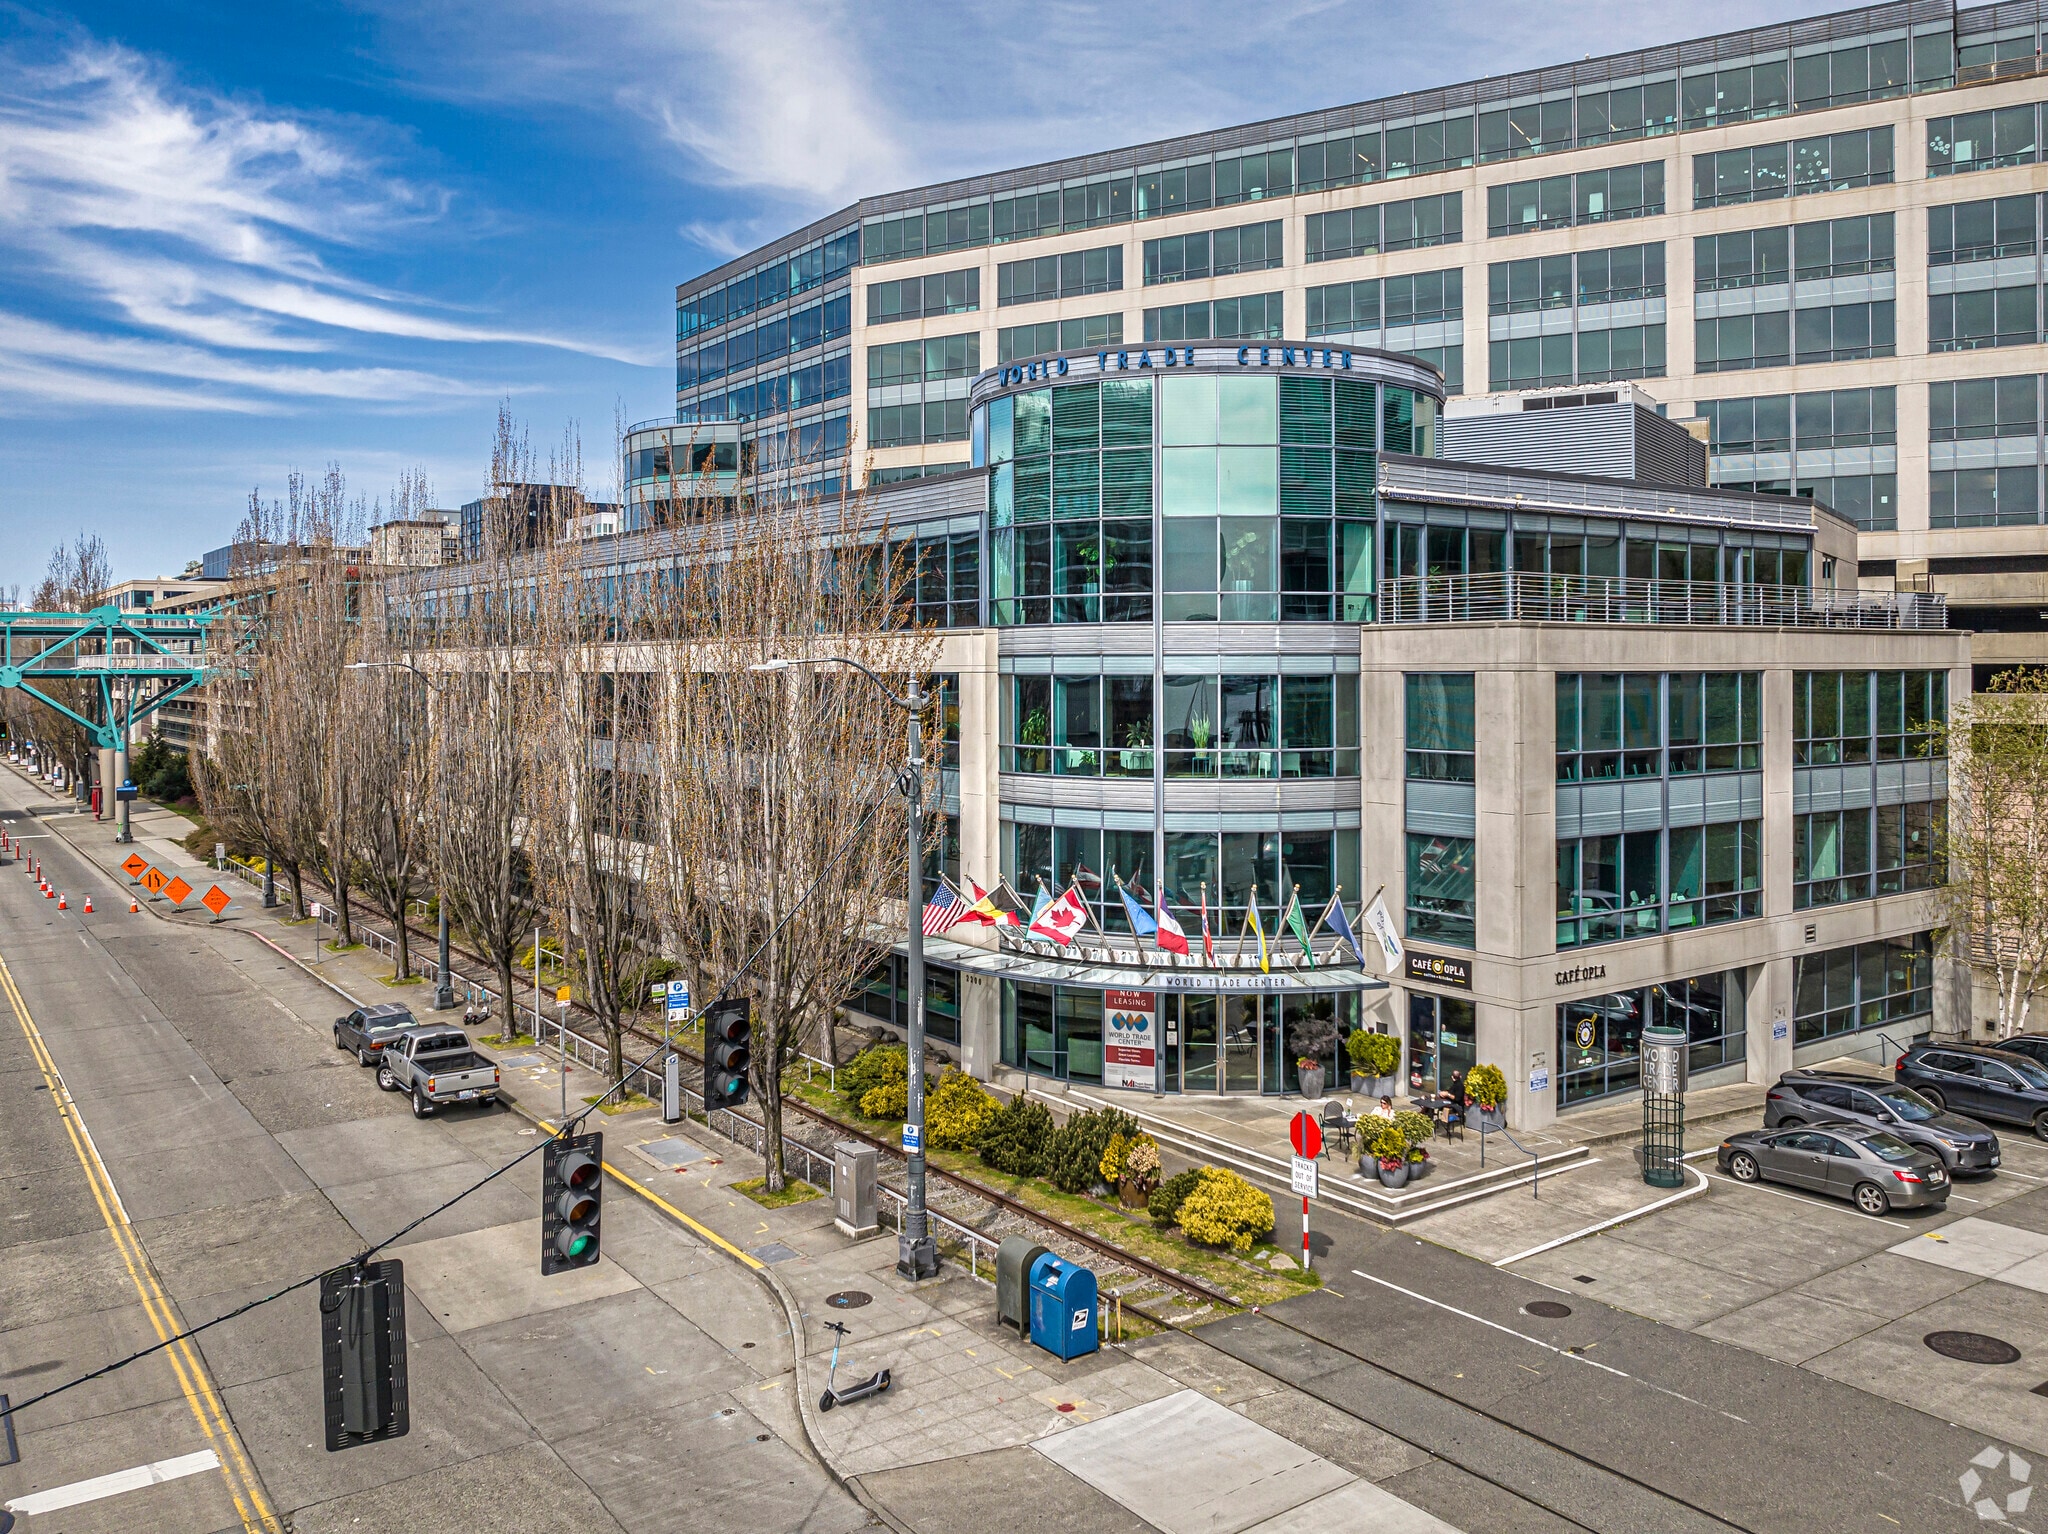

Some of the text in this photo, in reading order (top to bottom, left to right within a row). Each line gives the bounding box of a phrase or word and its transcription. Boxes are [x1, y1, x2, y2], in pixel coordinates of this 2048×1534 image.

[998, 345, 1353, 387] WORLD TRADE CENTER
[1412, 958, 1466, 977] CAFÉ OPLA
[1555, 965, 1606, 986] CAFÉ OPLA
[1166, 977, 1286, 987] WORLD TRADE CENTER
[1119, 990, 1140, 998] NOW
[1113, 997, 1147, 1007] LEASING
[1132, 1033, 1151, 1041] TRADE
[1643, 1047, 1679, 1091] WORLD TRADE CENTER
[1122, 1079, 1135, 1087] NAI
[1294, 1160, 1313, 1173] TRACKS
[1295, 1171, 1312, 1182] OUT OF
[1294, 1181, 1314, 1193] SERVICE
